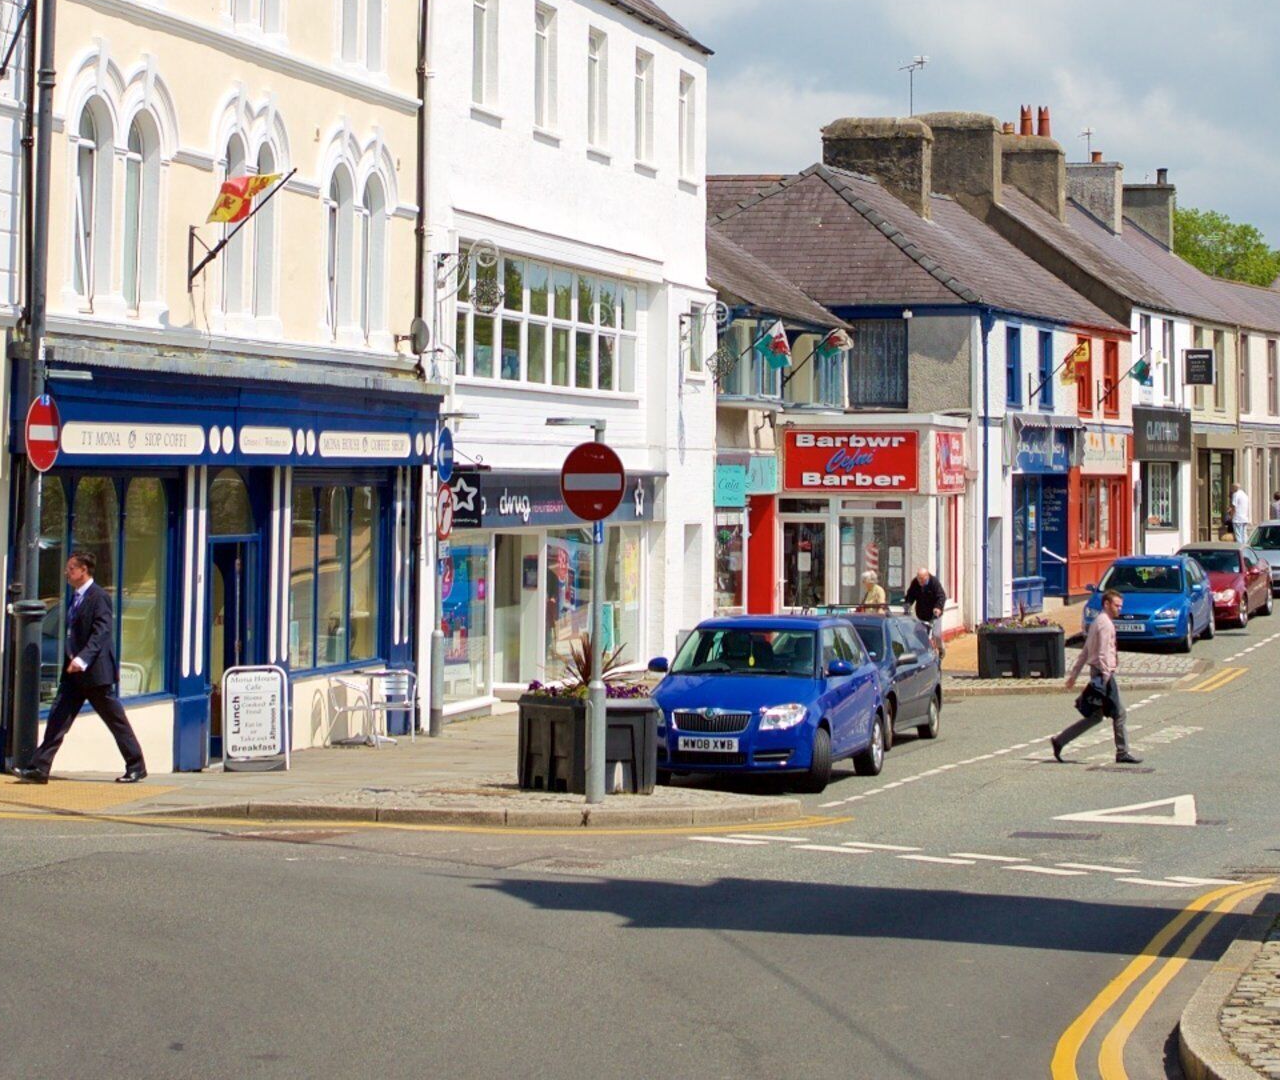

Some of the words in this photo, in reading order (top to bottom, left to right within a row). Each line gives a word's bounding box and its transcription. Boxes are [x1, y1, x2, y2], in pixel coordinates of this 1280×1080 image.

[95, 431, 121, 446] MONA
[163, 433, 188, 447] COFFI
[796, 433, 906, 447] Barbwr
[802, 473, 906, 487] Barber
[499, 487, 532, 522] drug
[232, 696, 241, 734] Lunch
[231, 743, 277, 752] Breakfast
[683, 738, 710, 749] MW08
